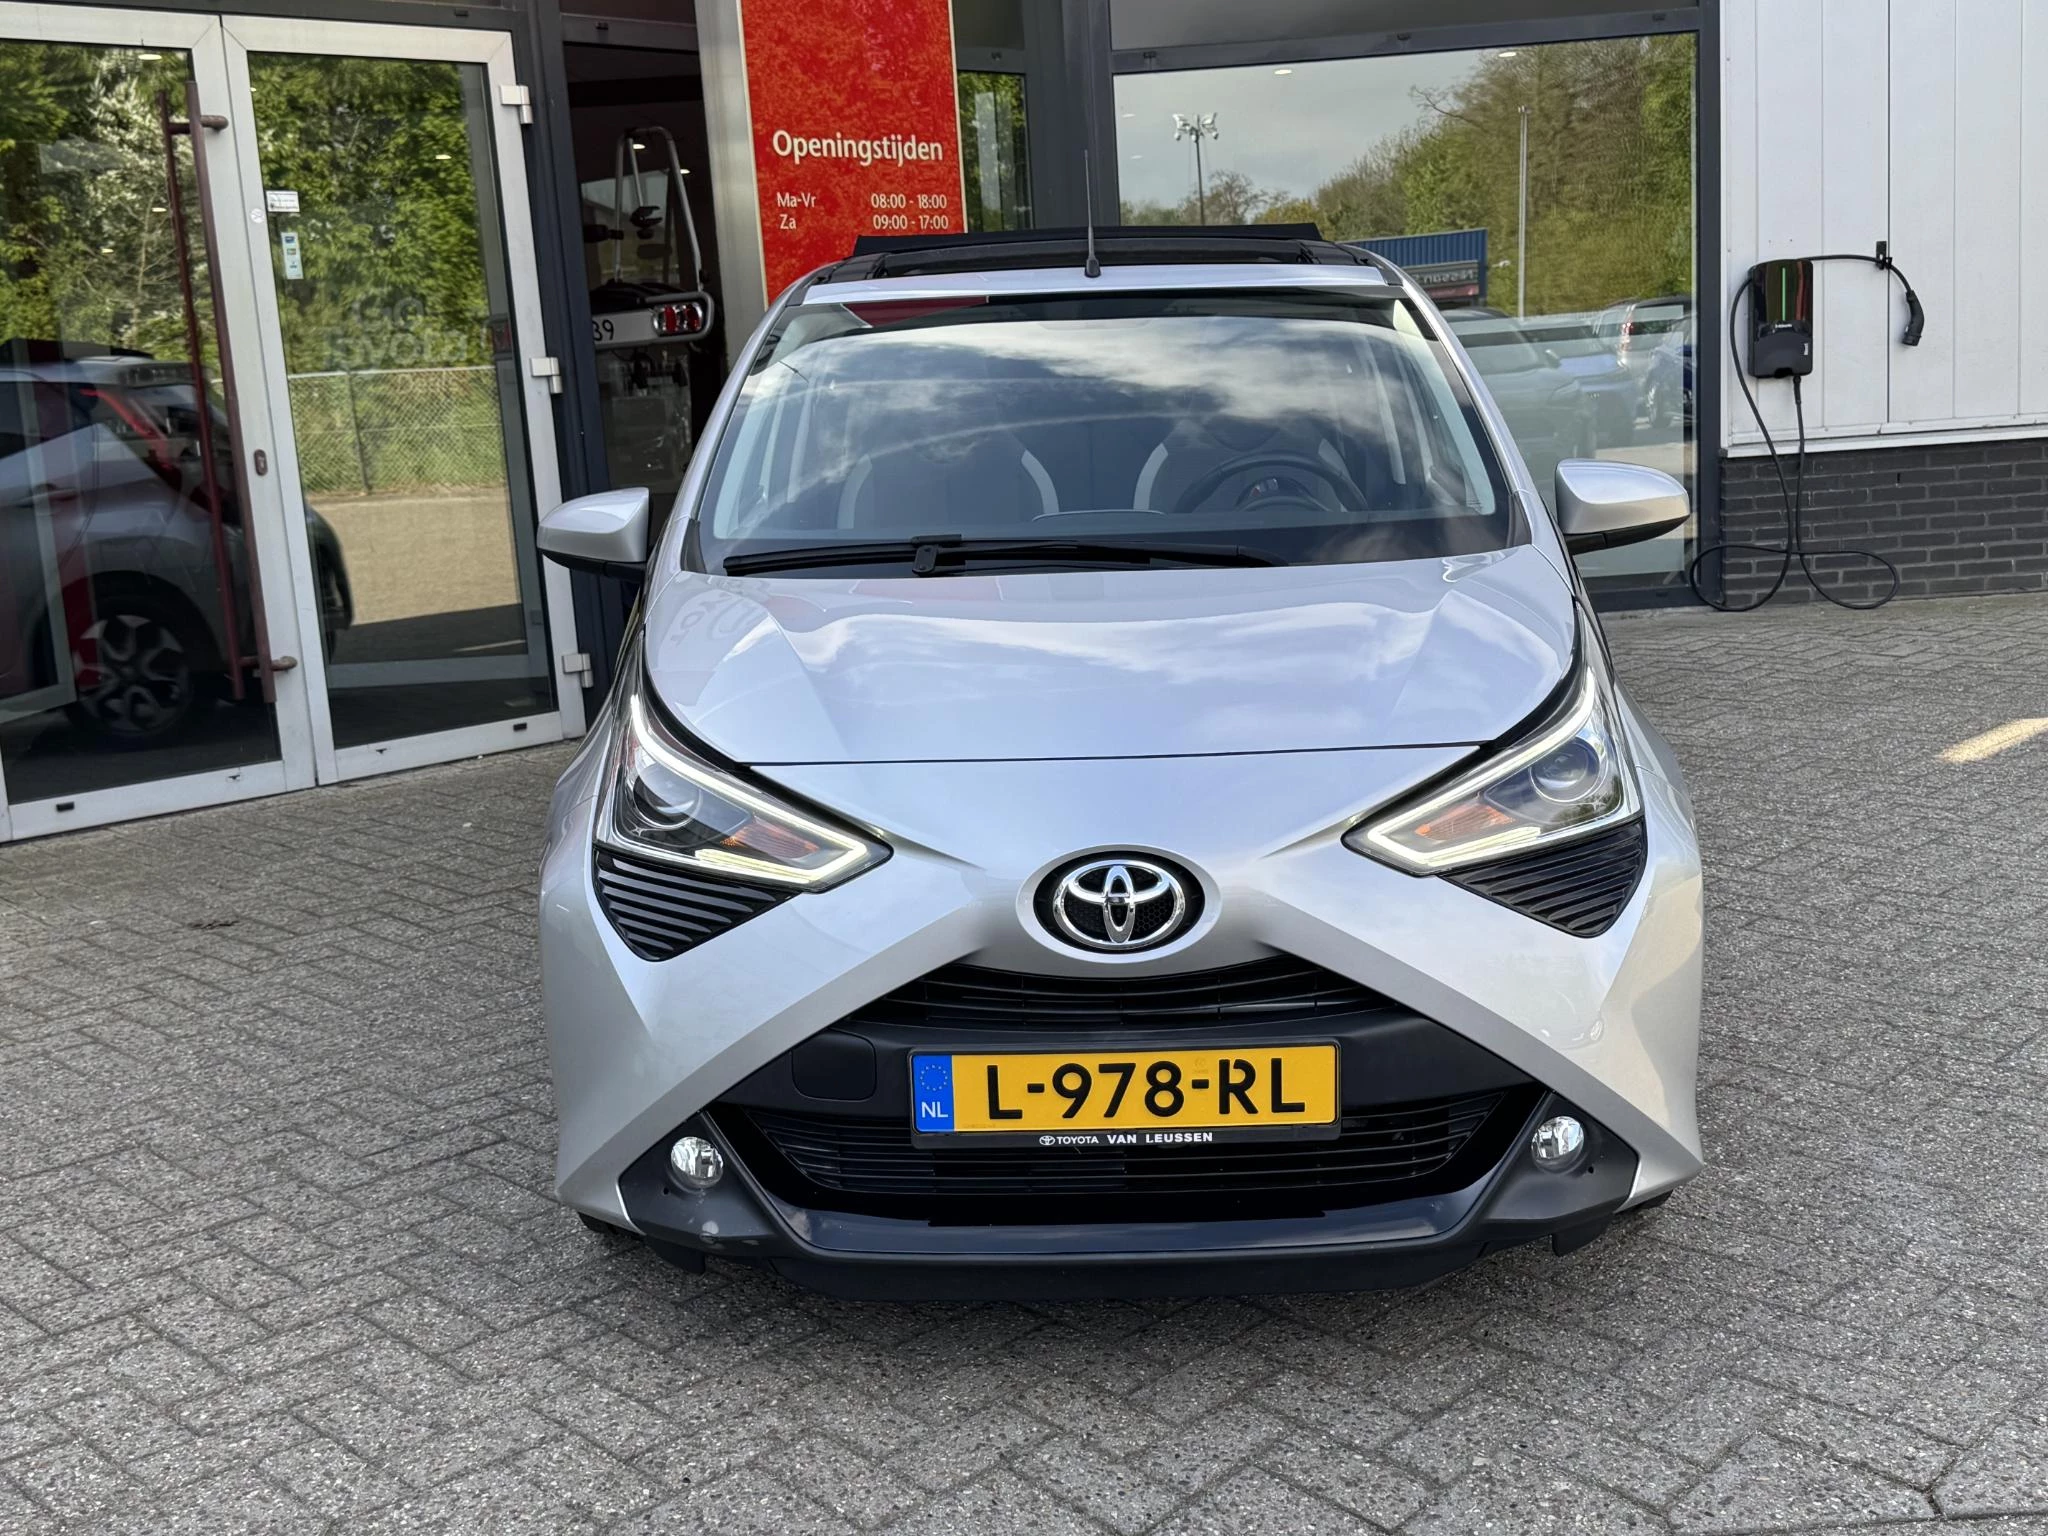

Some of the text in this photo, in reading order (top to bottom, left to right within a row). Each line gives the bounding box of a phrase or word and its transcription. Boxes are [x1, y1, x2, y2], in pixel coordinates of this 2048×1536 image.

[773, 129, 943, 168] Openingstijden
[776, 191, 816, 208] Ma-Vr
[871, 193, 906, 209] 08:00
[917, 194, 947, 209] 18:00
[779, 213, 797, 230] Za
[873, 214, 908, 230] 09:00
[919, 215, 948, 230] 17:00
[987, 1057, 1306, 1120] L-978-RL
[921, 1101, 949, 1119] NL
[1057, 1132, 1213, 1145] TOYOTA VAN LEUSSEN
